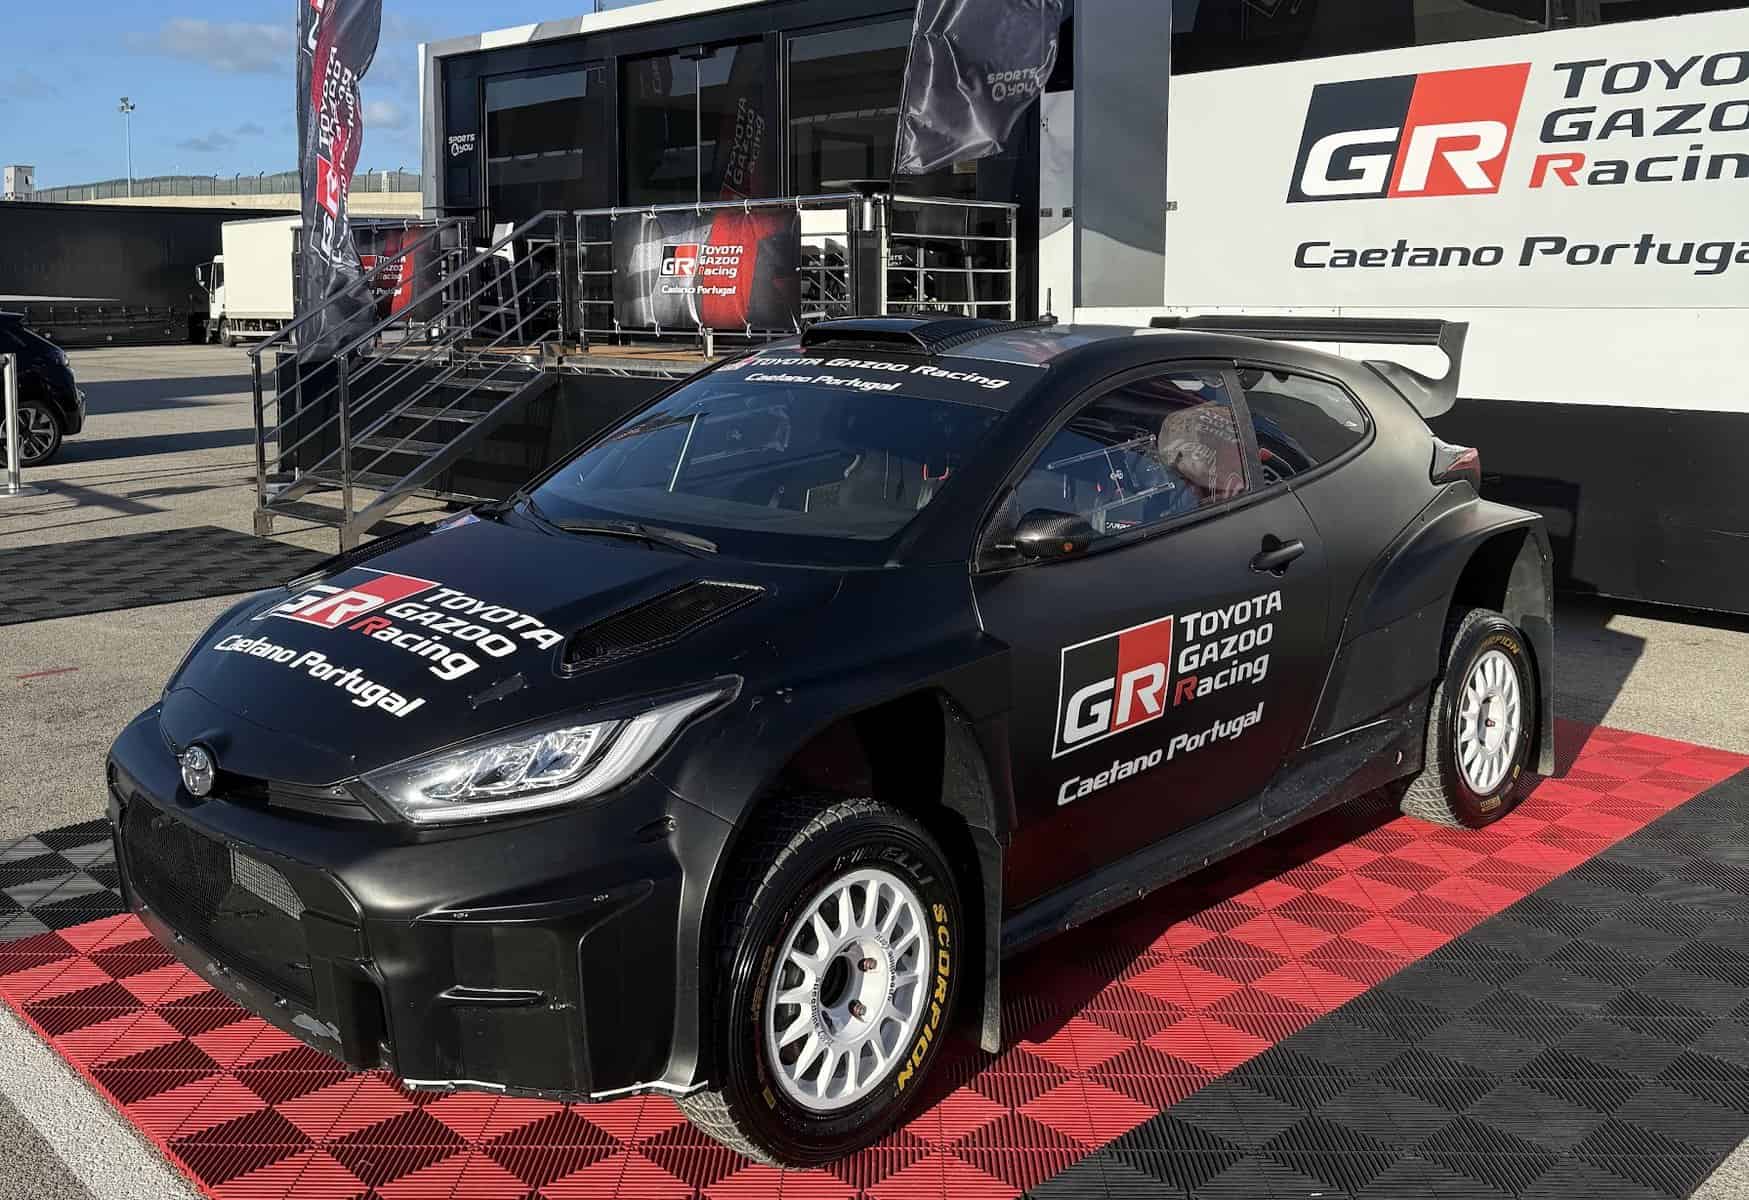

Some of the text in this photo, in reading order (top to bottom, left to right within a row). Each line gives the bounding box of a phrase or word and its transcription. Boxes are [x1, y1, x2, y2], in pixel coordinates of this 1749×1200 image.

[319, 46, 337, 149] TOYOTA
[987, 66, 1037, 84] SPORTS
[1553, 51, 1749, 98] TOYO
[448, 134, 475, 144] SPORTS
[1539, 99, 1749, 143] GAZO
[1300, 120, 1508, 197] GR
[1528, 144, 1749, 188] Racin
[662, 257, 695, 275] GR
[698, 266, 738, 279] Racing
[700, 256, 740, 265] GAZOO
[701, 245, 744, 255] TOYOTA
[1294, 239, 1504, 268] Caetano
[744, 373, 903, 391] Caetano Portugal
[752, 358, 825, 367] TOYOTA
[826, 358, 909, 372] GAZOO
[910, 366, 1010, 389] Racing
[384, 602, 518, 658] GAZOO
[424, 588, 565, 650] TOYOTA
[1180, 590, 1282, 642] TOYOTA
[348, 616, 480, 681] Racing
[1177, 623, 1273, 674] GAZOO
[214, 634, 427, 718] Caetano Portugal
[1173, 654, 1270, 707] Racing
[1063, 662, 1166, 744] GR
[1057, 701, 1265, 806] Caetano Portugal
[898, 903, 951, 1091] SCORPION
